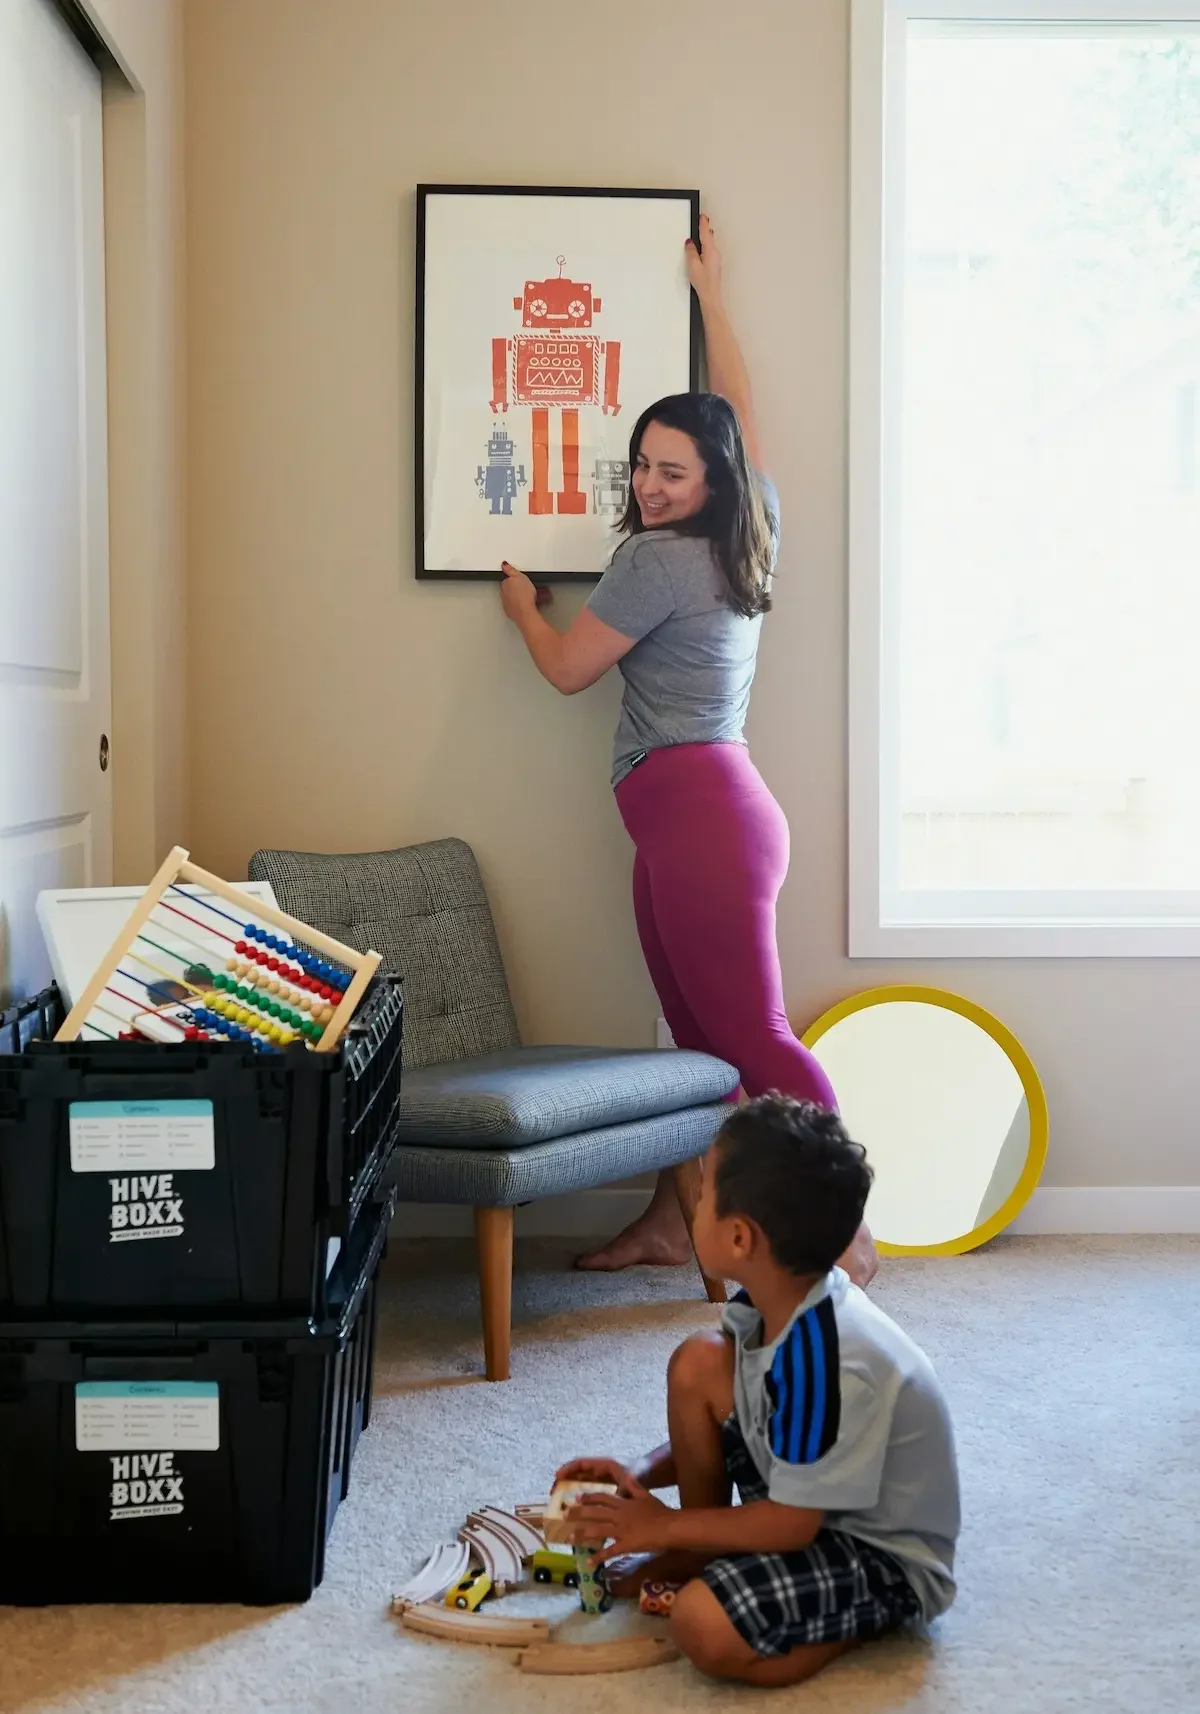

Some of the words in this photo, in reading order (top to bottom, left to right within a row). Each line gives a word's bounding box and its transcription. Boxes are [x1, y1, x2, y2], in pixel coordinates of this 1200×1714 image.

[109, 1174, 174, 1203] HIVE
[109, 1199, 184, 1228] BOXX
[110, 1452, 174, 1480] HIVE
[110, 1477, 184, 1506] BOXX
